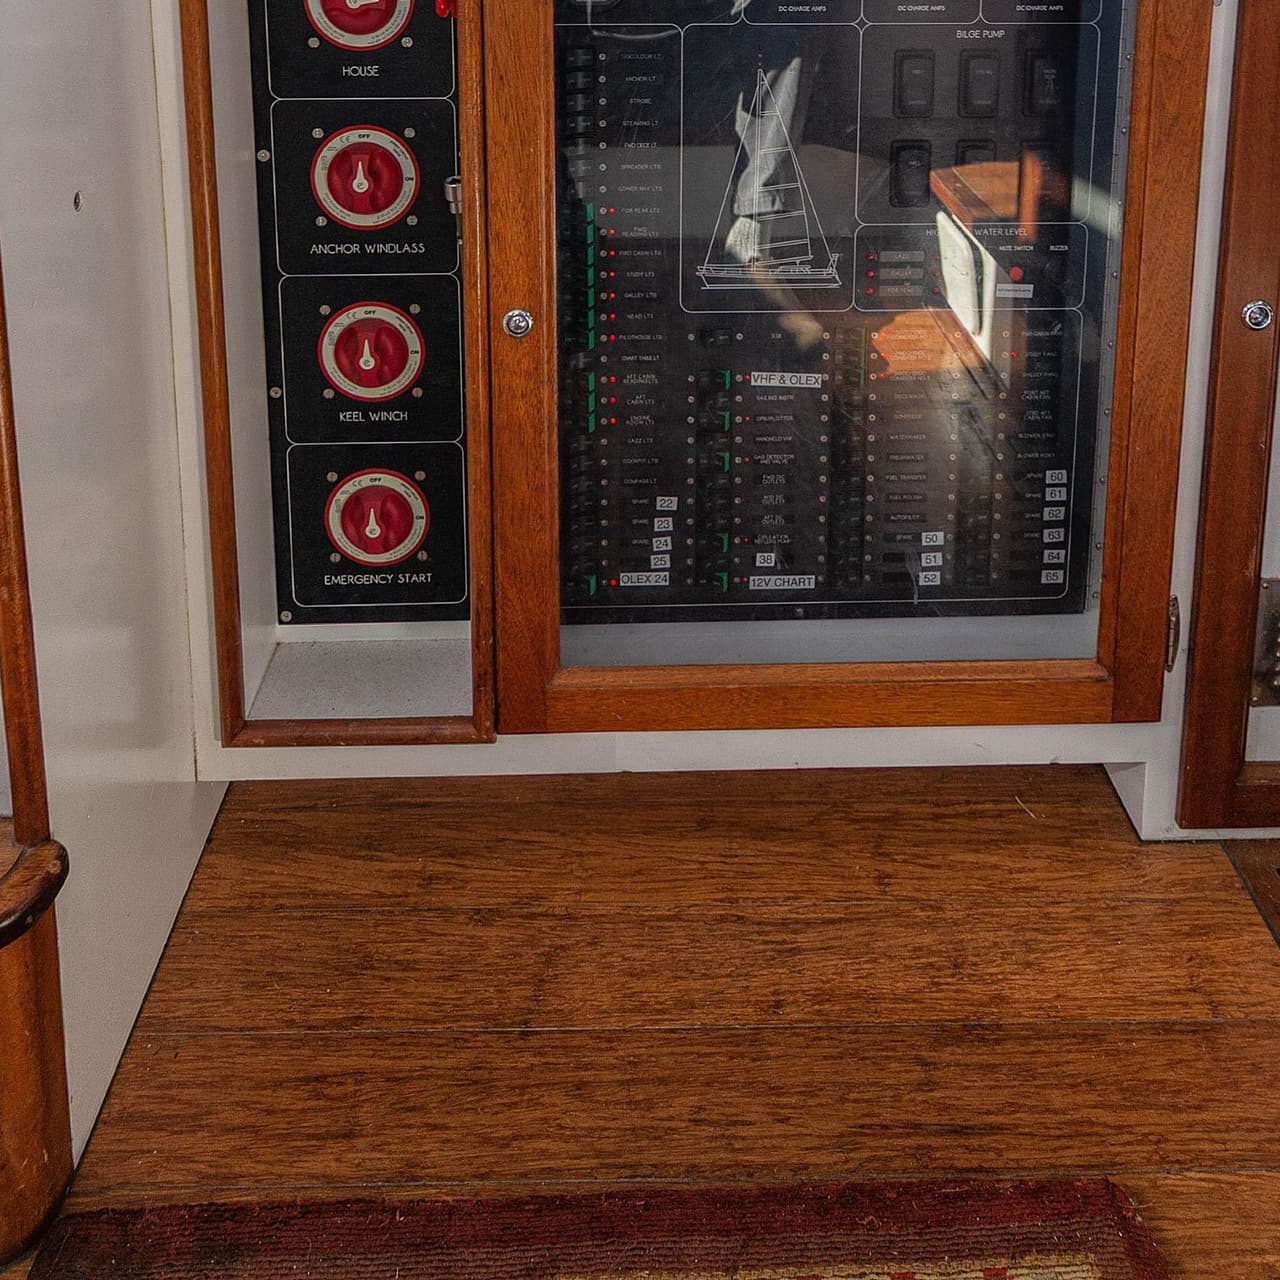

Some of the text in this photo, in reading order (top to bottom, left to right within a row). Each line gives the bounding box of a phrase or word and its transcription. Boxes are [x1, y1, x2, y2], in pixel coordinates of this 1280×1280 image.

[956, 30, 1006, 39] BILGE PUMP
[342, 66, 379, 77] HOUSE
[975, 228, 1028, 236] WATER LEVEL
[310, 243, 425, 254] ANCHOR WINDLASS
[752, 373, 821, 387] VHF & OLEX
[339, 411, 408, 422] KEEL WINCH
[1050, 473, 1063, 482] 60
[1050, 490, 1063, 499] 61
[660, 498, 673, 508] 22
[1048, 510, 1060, 519] 62
[657, 519, 670, 529] 23
[925, 533, 938, 543] 50
[1048, 531, 1060, 540] 63
[656, 539, 669, 548] 24
[654, 557, 667, 566] 25
[759, 554, 773, 564] 38
[925, 554, 939, 564] 51
[1048, 552, 1061, 561] 64
[324, 573, 432, 585] EMERGENCY START
[621, 574, 668, 584] OLEX 24
[923, 574, 937, 583] 52
[1046, 572, 1058, 581] 65
[751, 577, 813, 587] 12V CHART
